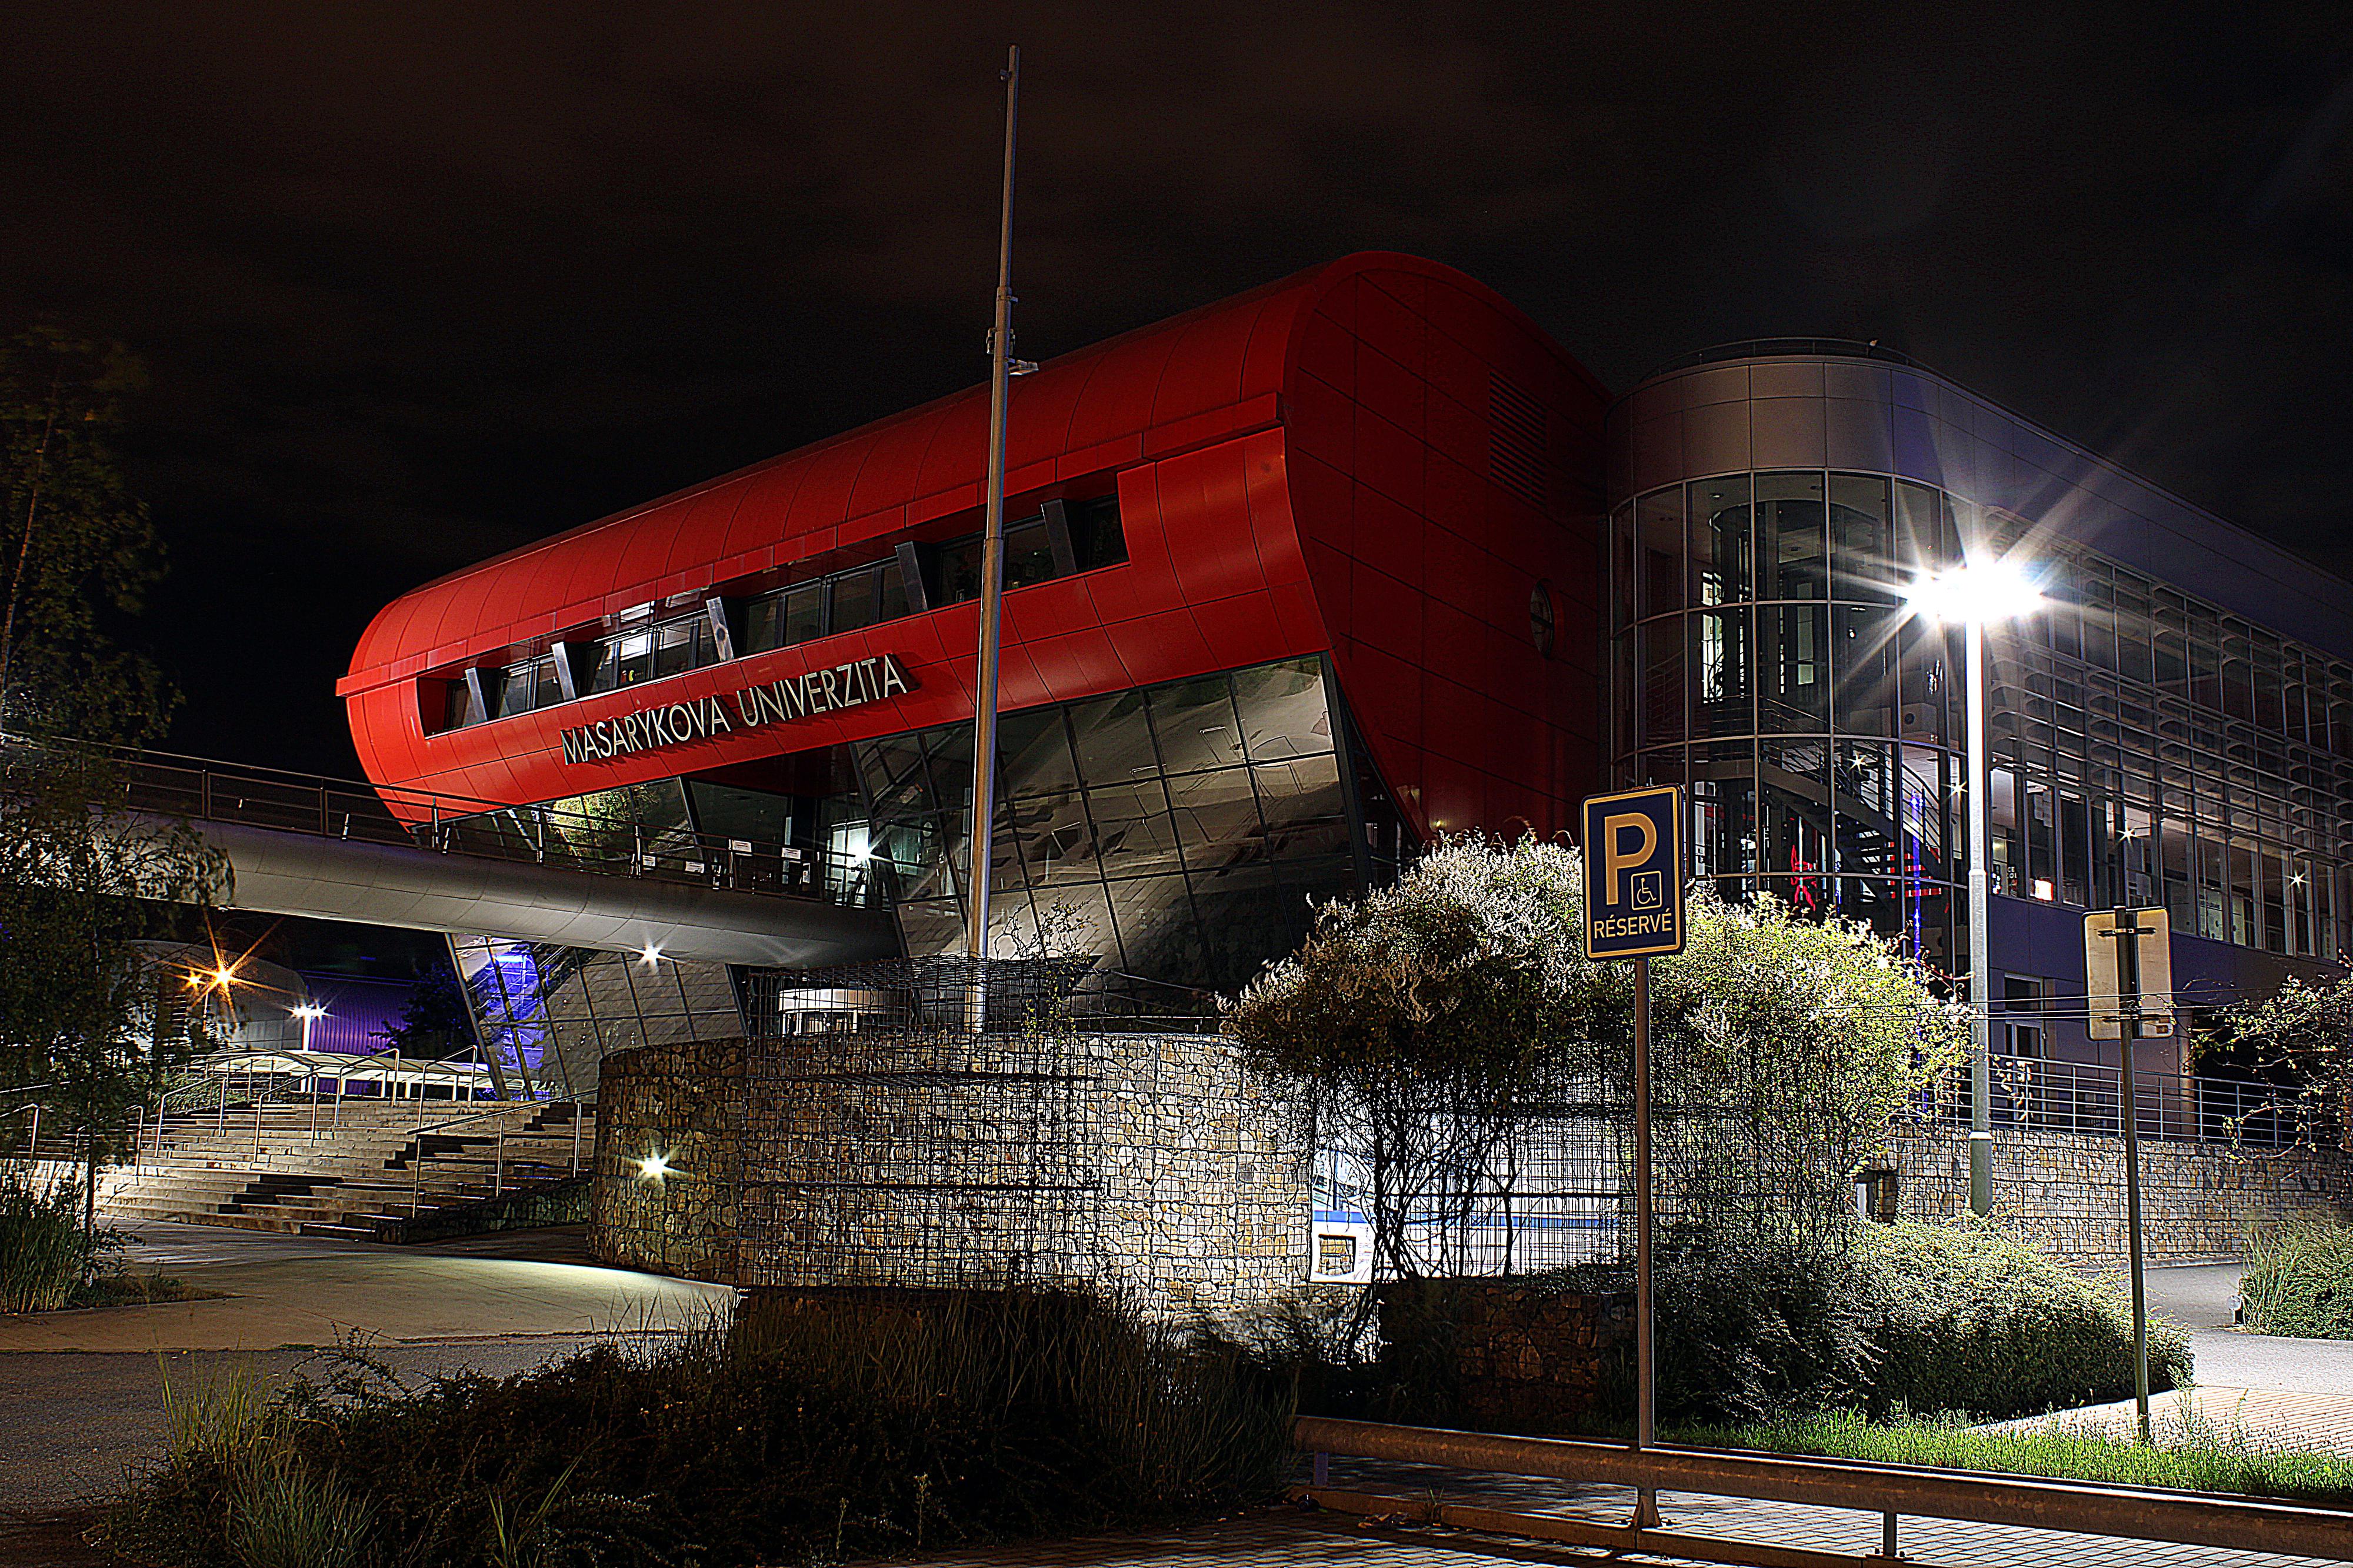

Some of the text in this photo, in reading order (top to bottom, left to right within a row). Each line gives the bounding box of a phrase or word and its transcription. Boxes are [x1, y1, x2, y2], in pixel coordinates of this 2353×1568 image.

[560, 653, 906, 766] MASARYKOVA UNIVERZITA
[1604, 812, 1657, 905] P
[1594, 908, 1672, 939] RÉSERVÉ
